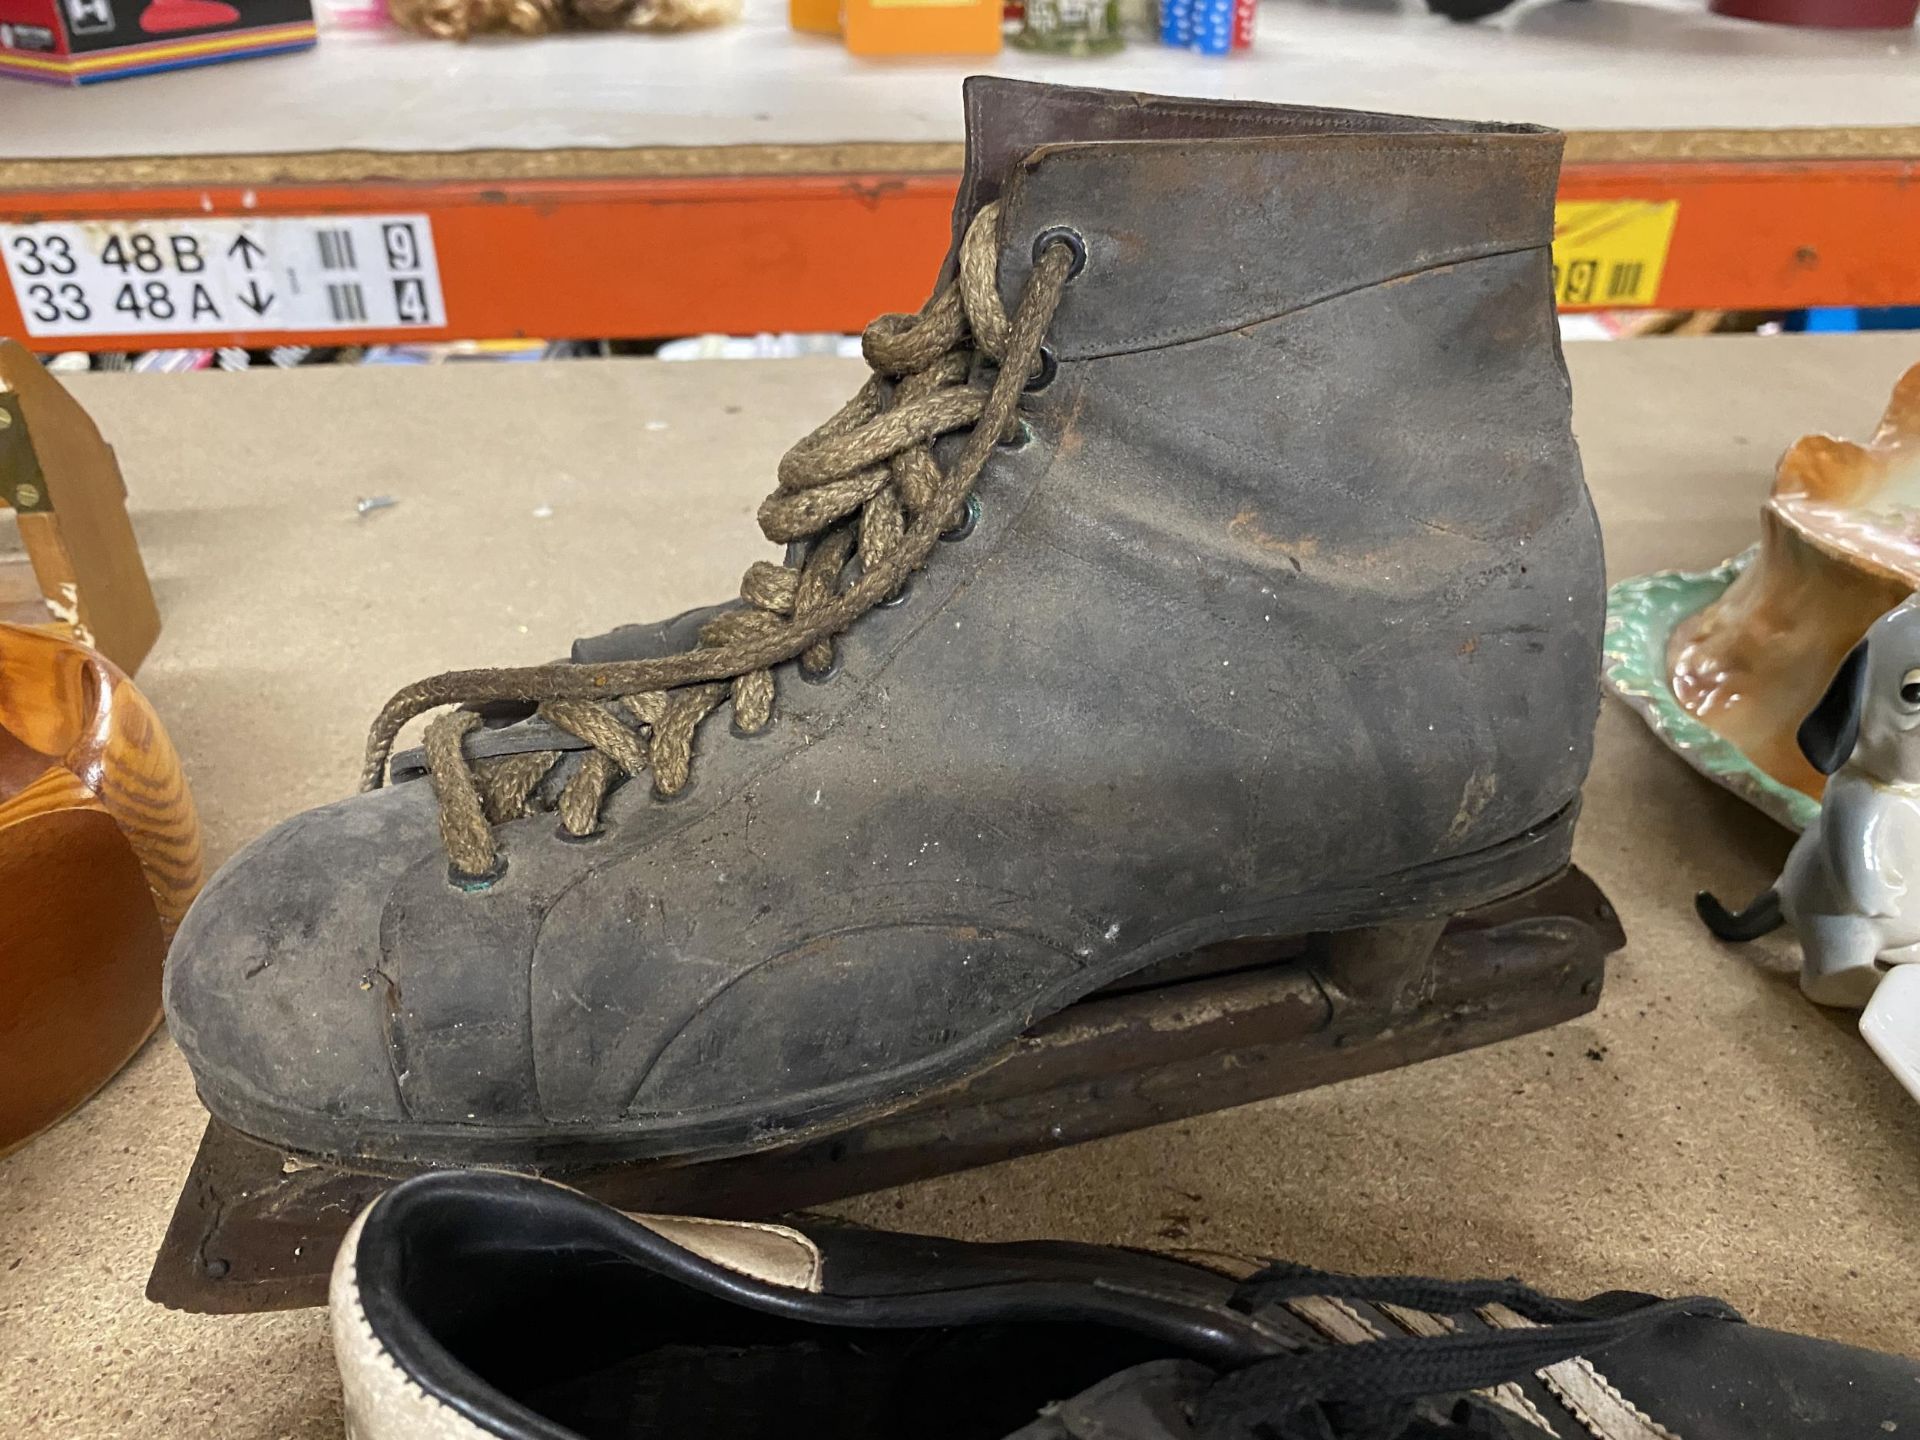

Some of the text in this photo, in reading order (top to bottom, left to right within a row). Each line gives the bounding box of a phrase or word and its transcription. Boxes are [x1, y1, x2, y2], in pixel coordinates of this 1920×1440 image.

[13, 235, 77, 276] 33
[385, 224, 418, 269] 9
[28, 282, 91, 323] 33
[396, 279, 428, 323] 4
